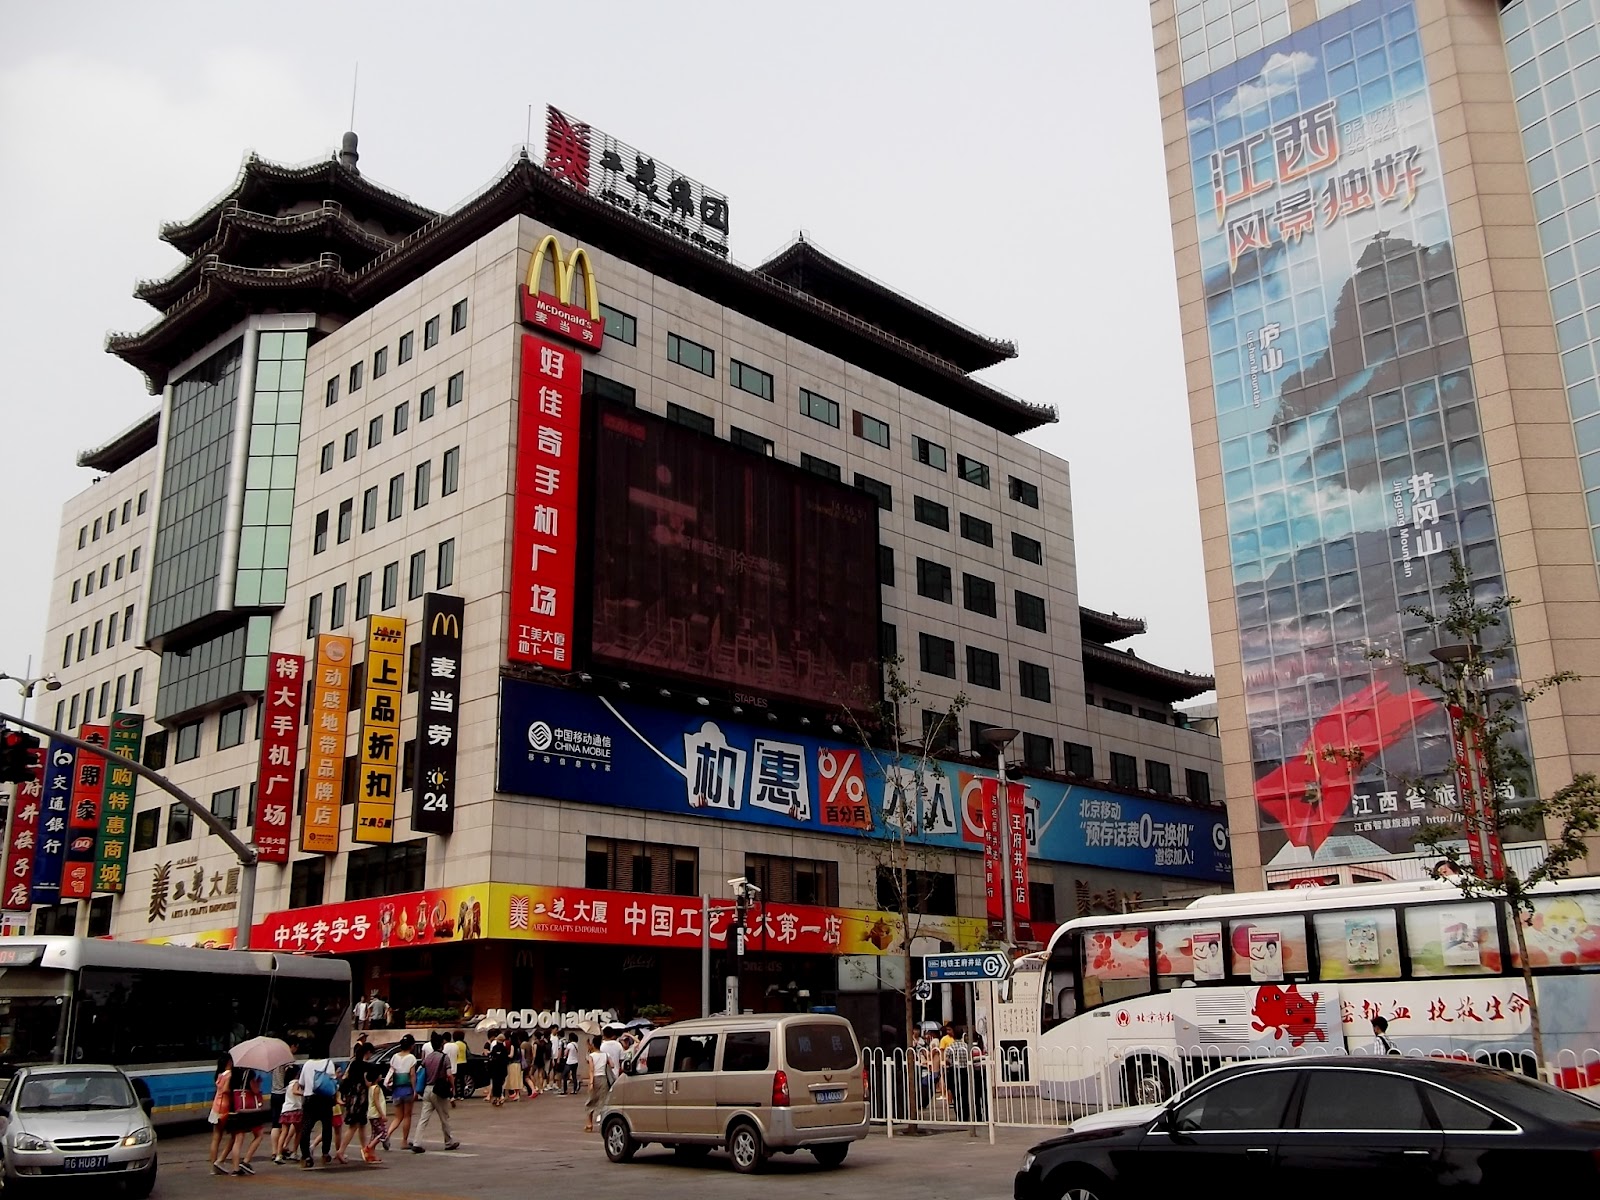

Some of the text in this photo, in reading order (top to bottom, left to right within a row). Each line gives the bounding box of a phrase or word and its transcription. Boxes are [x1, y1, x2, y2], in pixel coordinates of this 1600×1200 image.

[1210, 100, 1339, 228] 江西
[1227, 145, 1424, 274] 风景独好
[535, 311, 593, 342] 麦当劳
[537, 300, 593, 329] McDonald's
[1259, 322, 1283, 373] 庐山
[1247, 331, 1261, 408] Lushan Mountain
[530, 346, 565, 617] 好佳奇手机广场
[1393, 480, 1412, 578] Jinggang Mountain
[1408, 471, 1442, 556] 井冈山
[518, 640, 565, 662] 地下一层
[519, 624, 565, 646] 工美大厦
[428, 657, 456, 747] 麦当劳
[734, 692, 768, 709] STAPLES
[263, 658, 299, 827] 特大手机广场
[366, 659, 397, 798] 上品折扣
[554, 728, 611, 748] 中国移动通信
[314, 669, 342, 825] 动感地带品牌店
[554, 741, 611, 758] CHINA MOBILE
[423, 792, 448, 812] 24
[1079, 799, 1121, 820] 北京移动
[1353, 777, 1516, 816] 江西省旅局
[825, 805, 866, 823] 百分百
[1353, 816, 1422, 833] 江西智慧旅游网
[1011, 814, 1026, 903] 王府井书店
[533, 897, 608, 923] 工美大厦
[274, 914, 371, 948] 中华老字号
[532, 923, 607, 934] ARTS CRAFTS EMPORIUM
[1426, 992, 1530, 1024] 挽救生命
[78, 1156, 107, 1169] HU871
